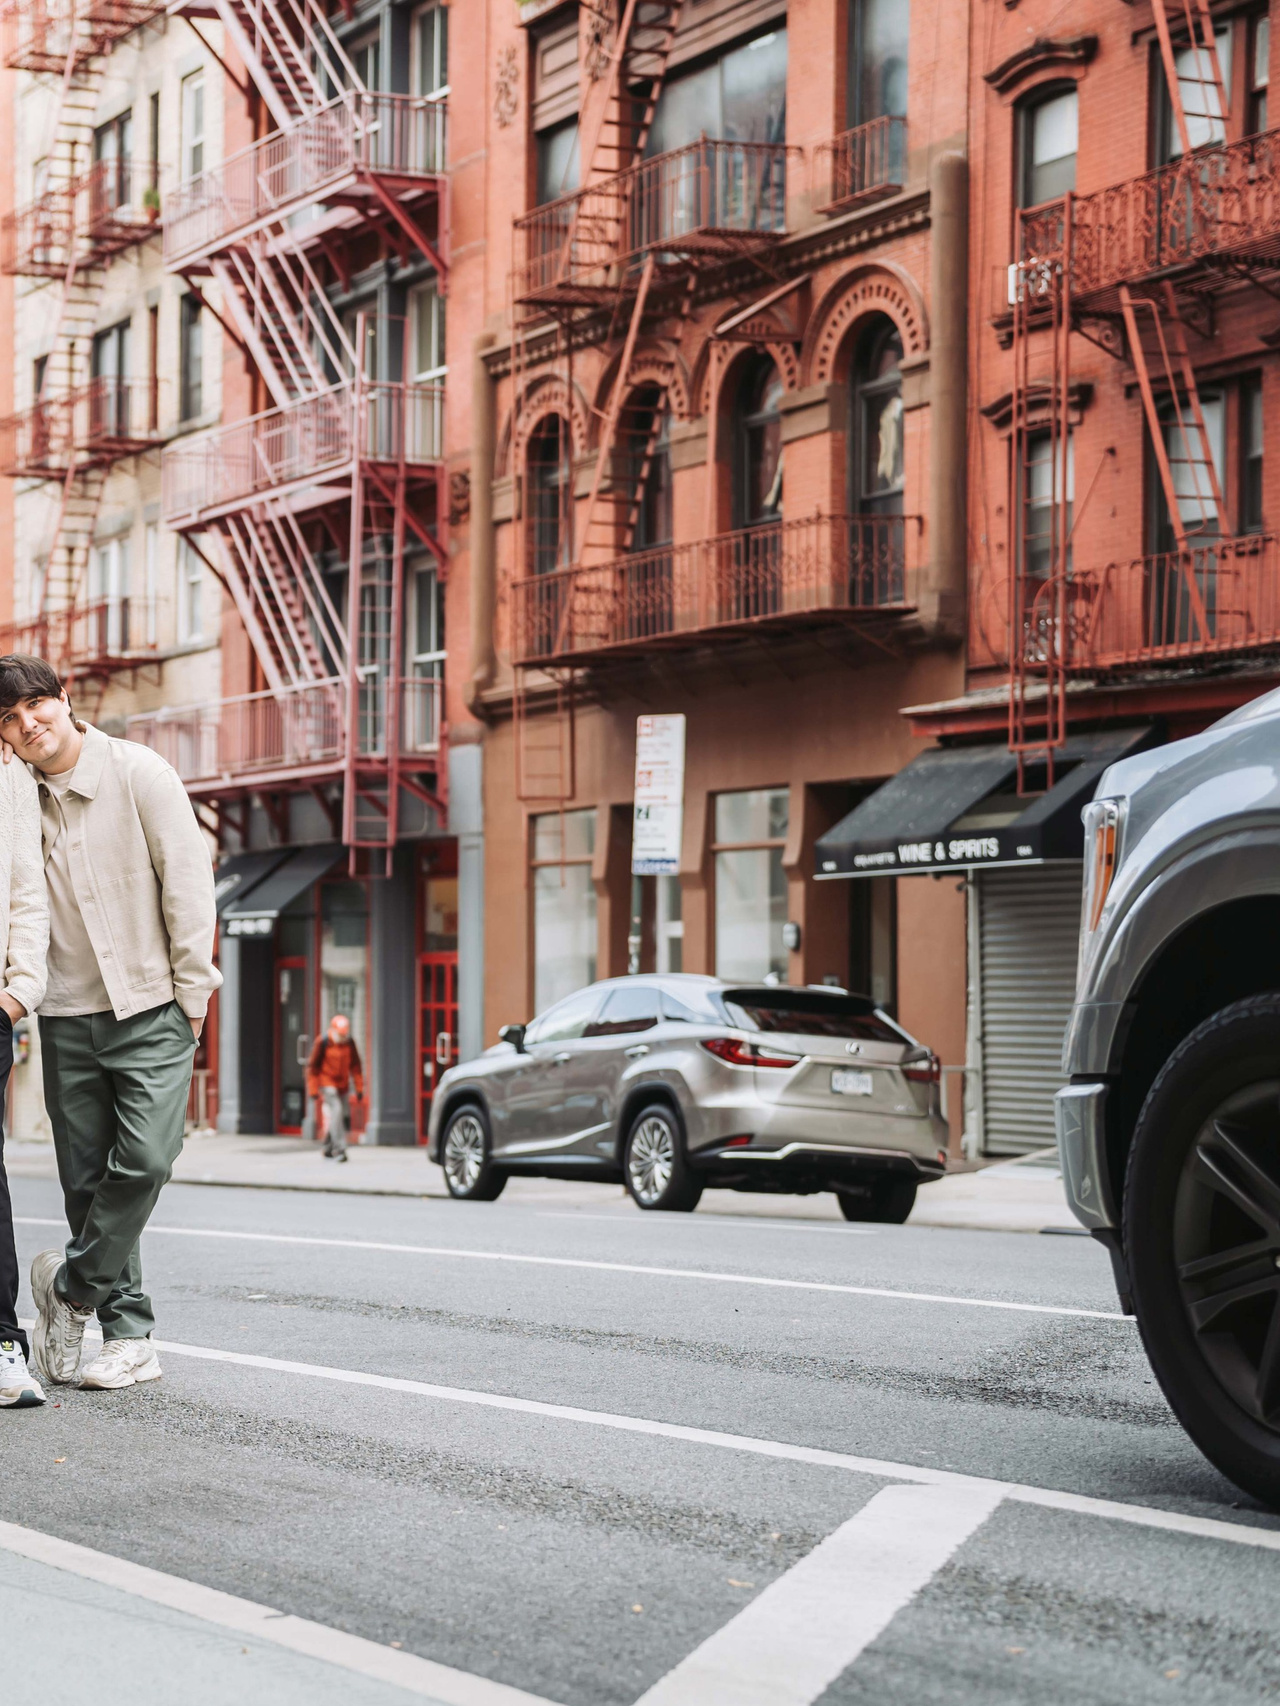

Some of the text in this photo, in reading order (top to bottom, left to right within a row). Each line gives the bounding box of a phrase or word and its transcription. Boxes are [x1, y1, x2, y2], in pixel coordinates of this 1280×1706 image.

[898, 842, 933, 863] WINE
[934, 841, 946, 861] &
[948, 837, 999, 860] SPIRITS
